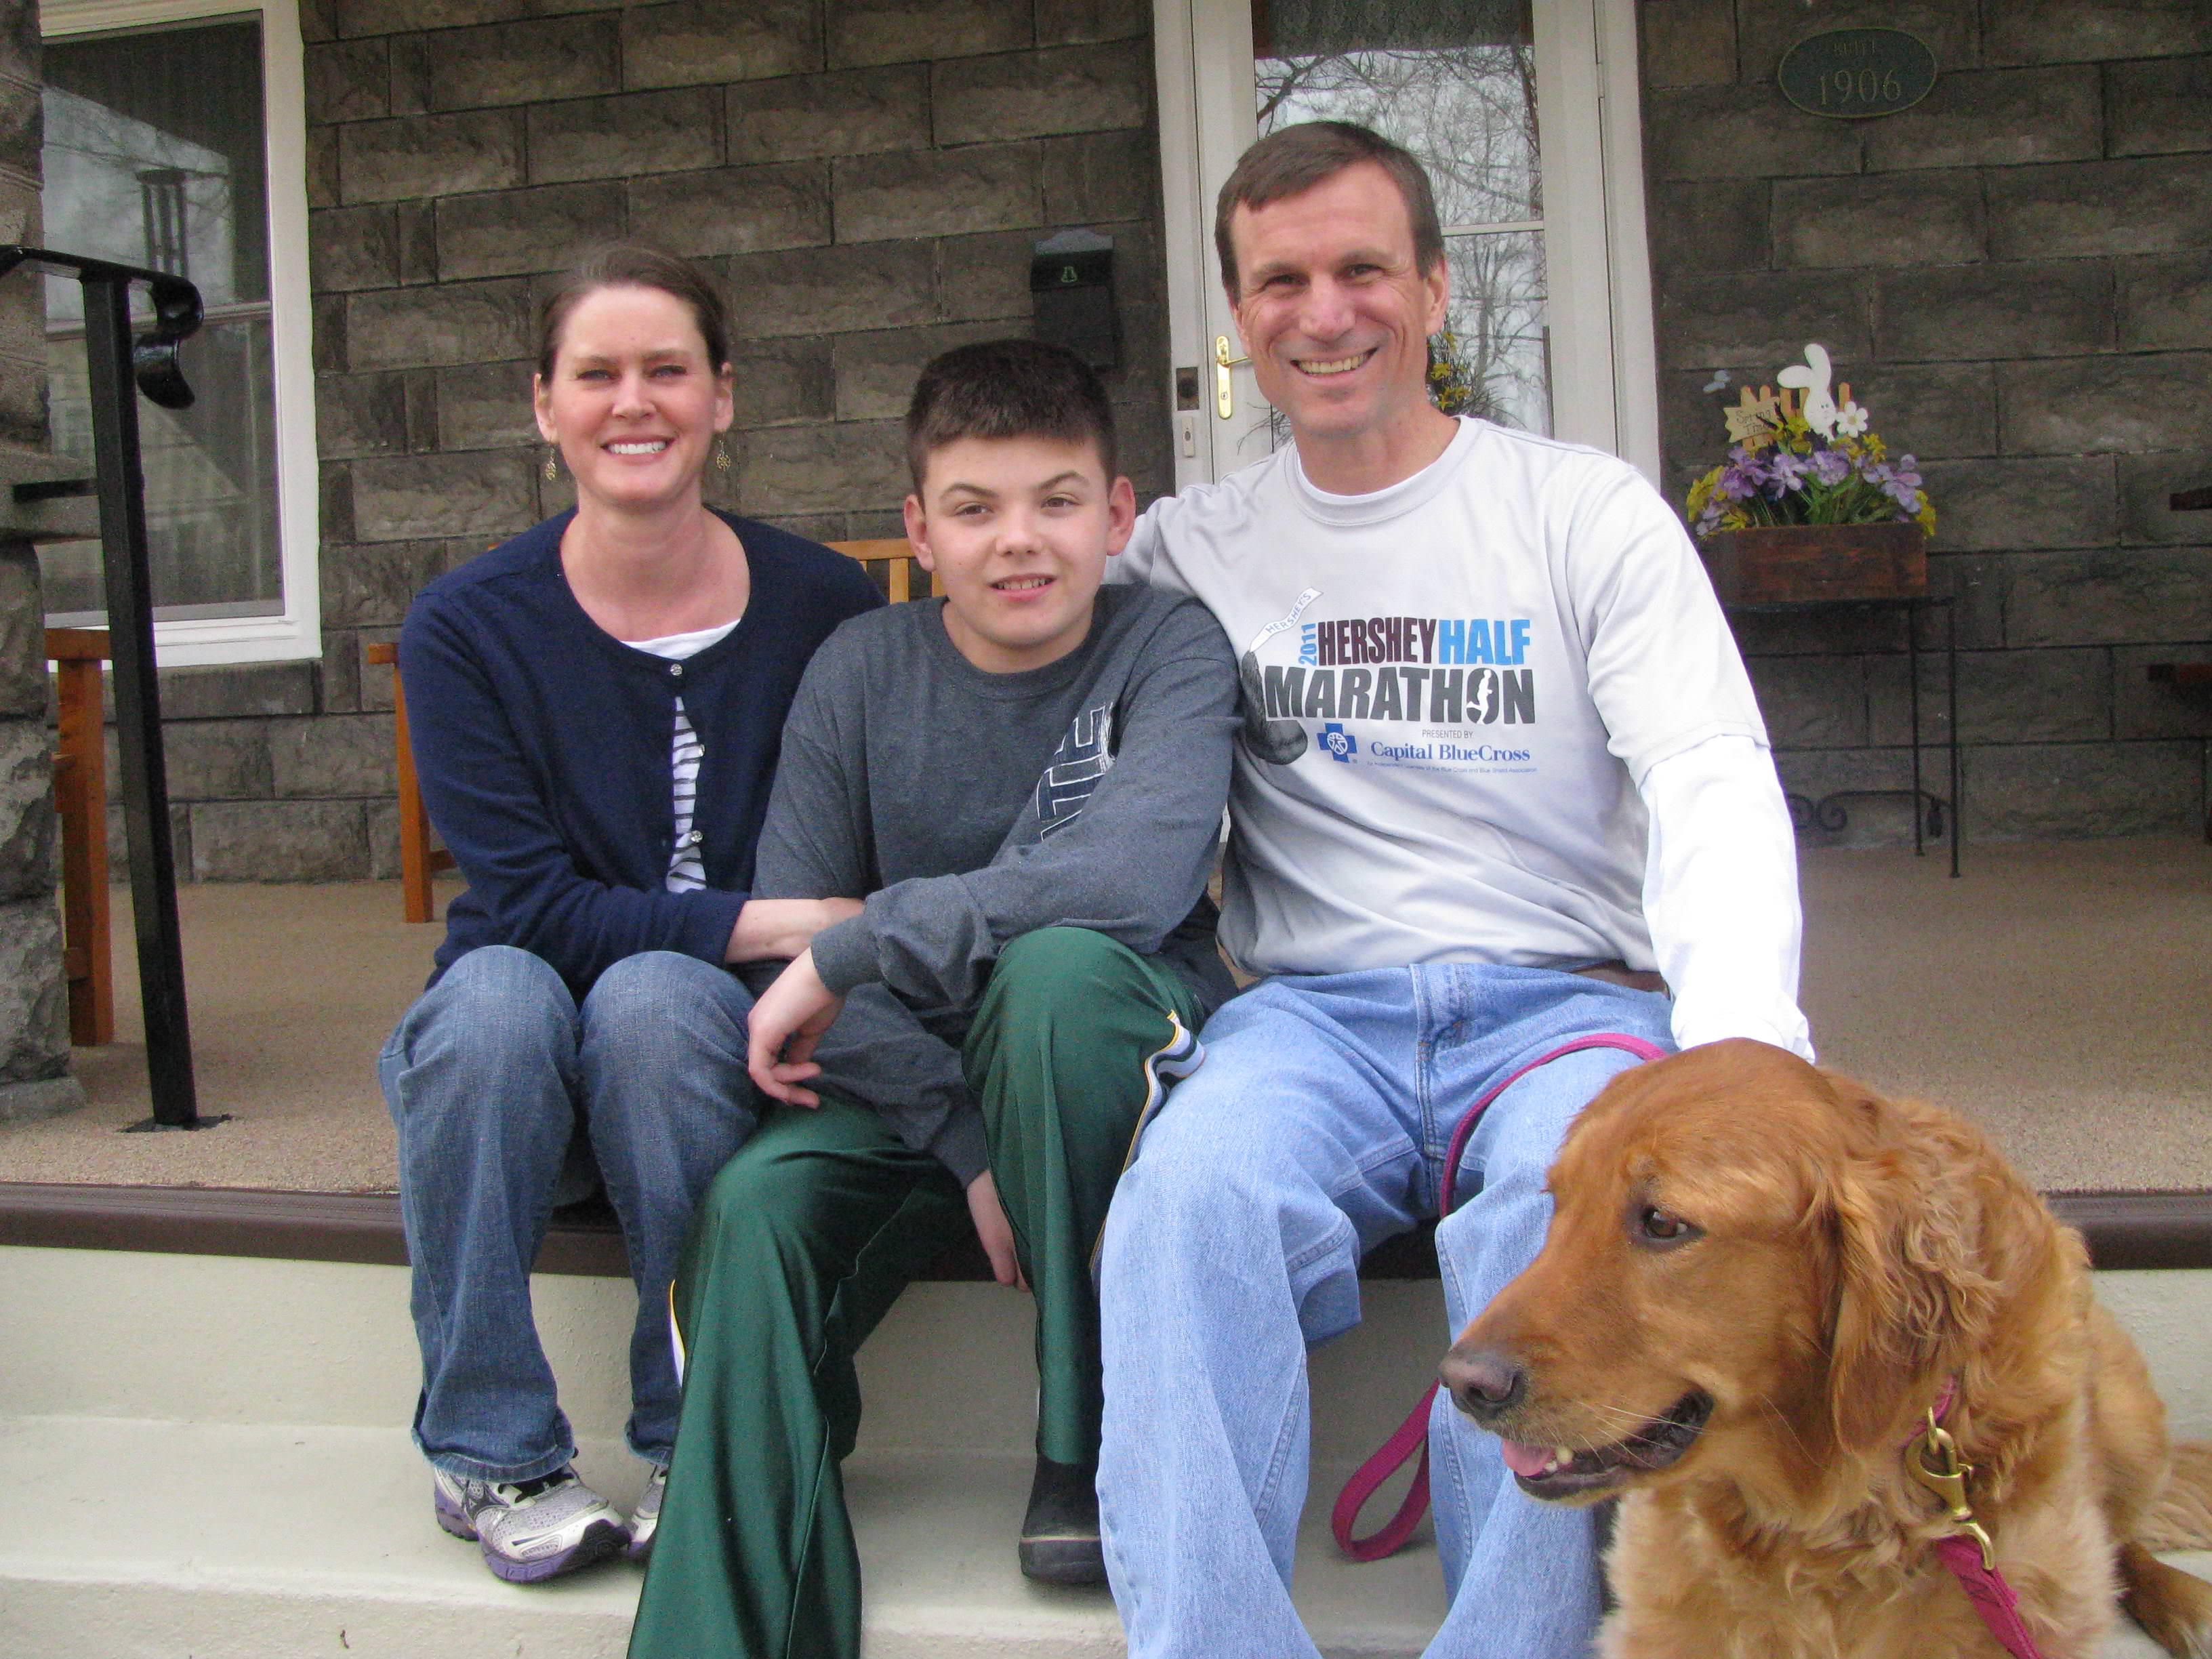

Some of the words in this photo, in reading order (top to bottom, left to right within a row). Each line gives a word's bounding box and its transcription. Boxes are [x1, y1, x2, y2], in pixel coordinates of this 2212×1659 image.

[1820, 67, 1902, 105] 1906
[1265, 592, 1312, 634] HERSHEY'S
[1298, 623, 1317, 667] 2011
[1317, 617, 1437, 666] HERSHEY
[1438, 618, 1531, 665] HALF
[1264, 665, 1536, 724] MARATHON
[1370, 741, 1432, 761] Capital
[1439, 743, 1531, 762] BlueCross
[1422, 729, 1462, 739] PRESENTED
[1463, 731, 1474, 739] BY
